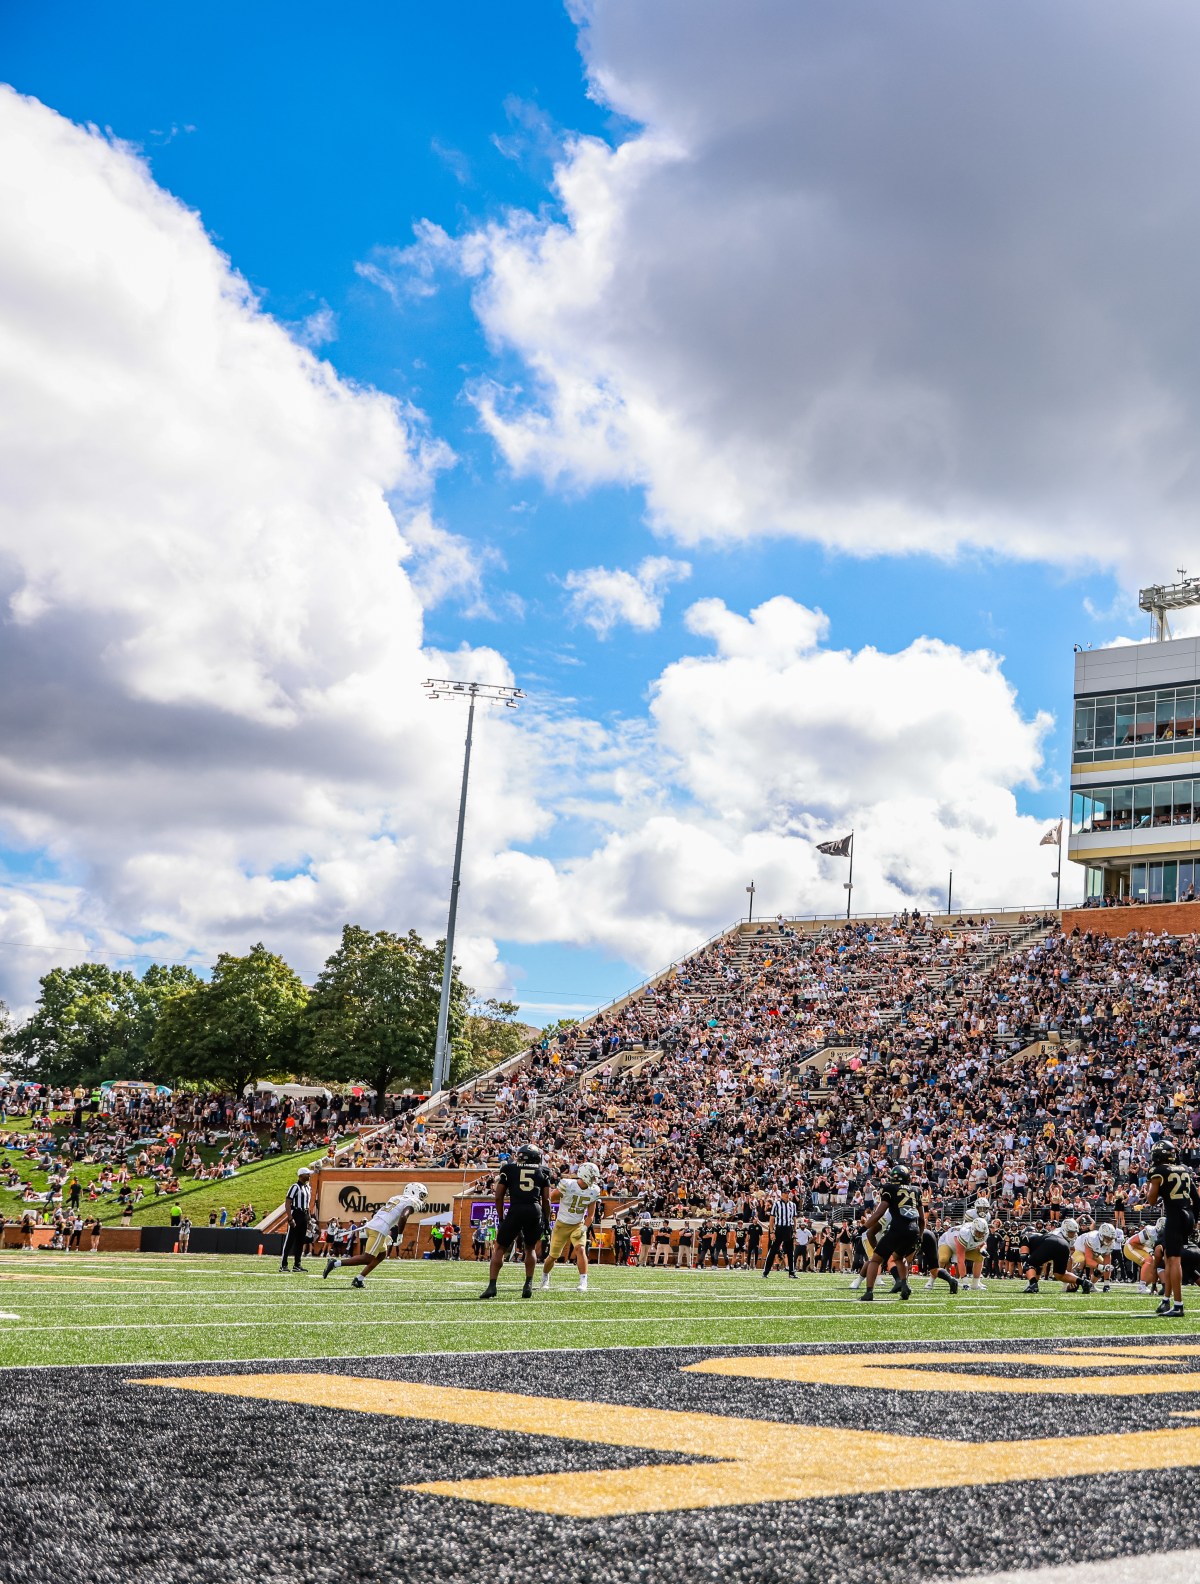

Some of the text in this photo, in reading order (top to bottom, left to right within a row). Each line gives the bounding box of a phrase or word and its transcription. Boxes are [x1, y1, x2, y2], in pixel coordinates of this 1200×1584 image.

[625, 1054, 632, 1062] 10
[830, 1050, 836, 1058] 9
[519, 1168, 536, 1193] 5
[1167, 1172, 1192, 1201] 23
[567, 1194, 591, 1214] 15
[896, 1188, 918, 1209] 21
[718, 1228, 727, 1236] 43
[1010, 1236, 1021, 1245] 30
